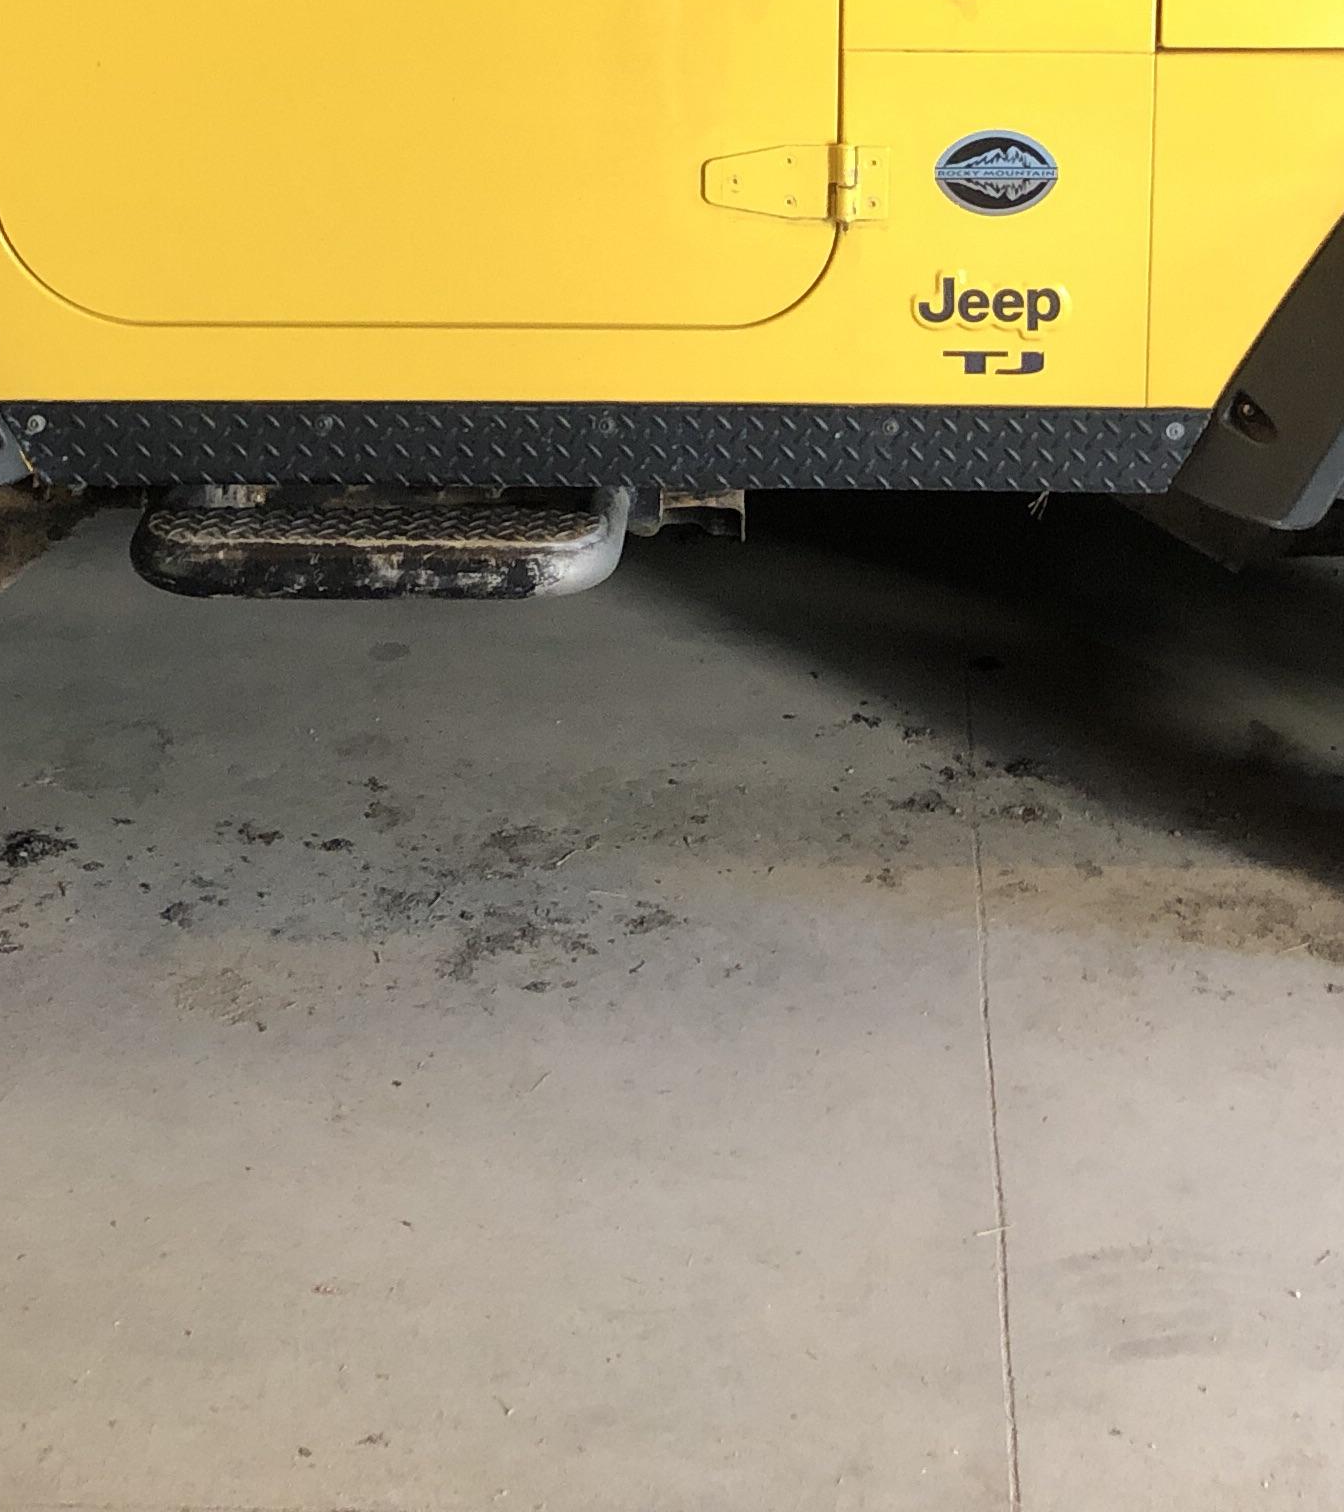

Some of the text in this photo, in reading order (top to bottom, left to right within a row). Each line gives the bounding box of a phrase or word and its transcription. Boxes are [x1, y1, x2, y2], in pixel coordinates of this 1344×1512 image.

[937, 170, 1055, 178] ROCKY MOUNTAIN
[918, 277, 1061, 331] Jeep
[942, 350, 1044, 375] TJ
